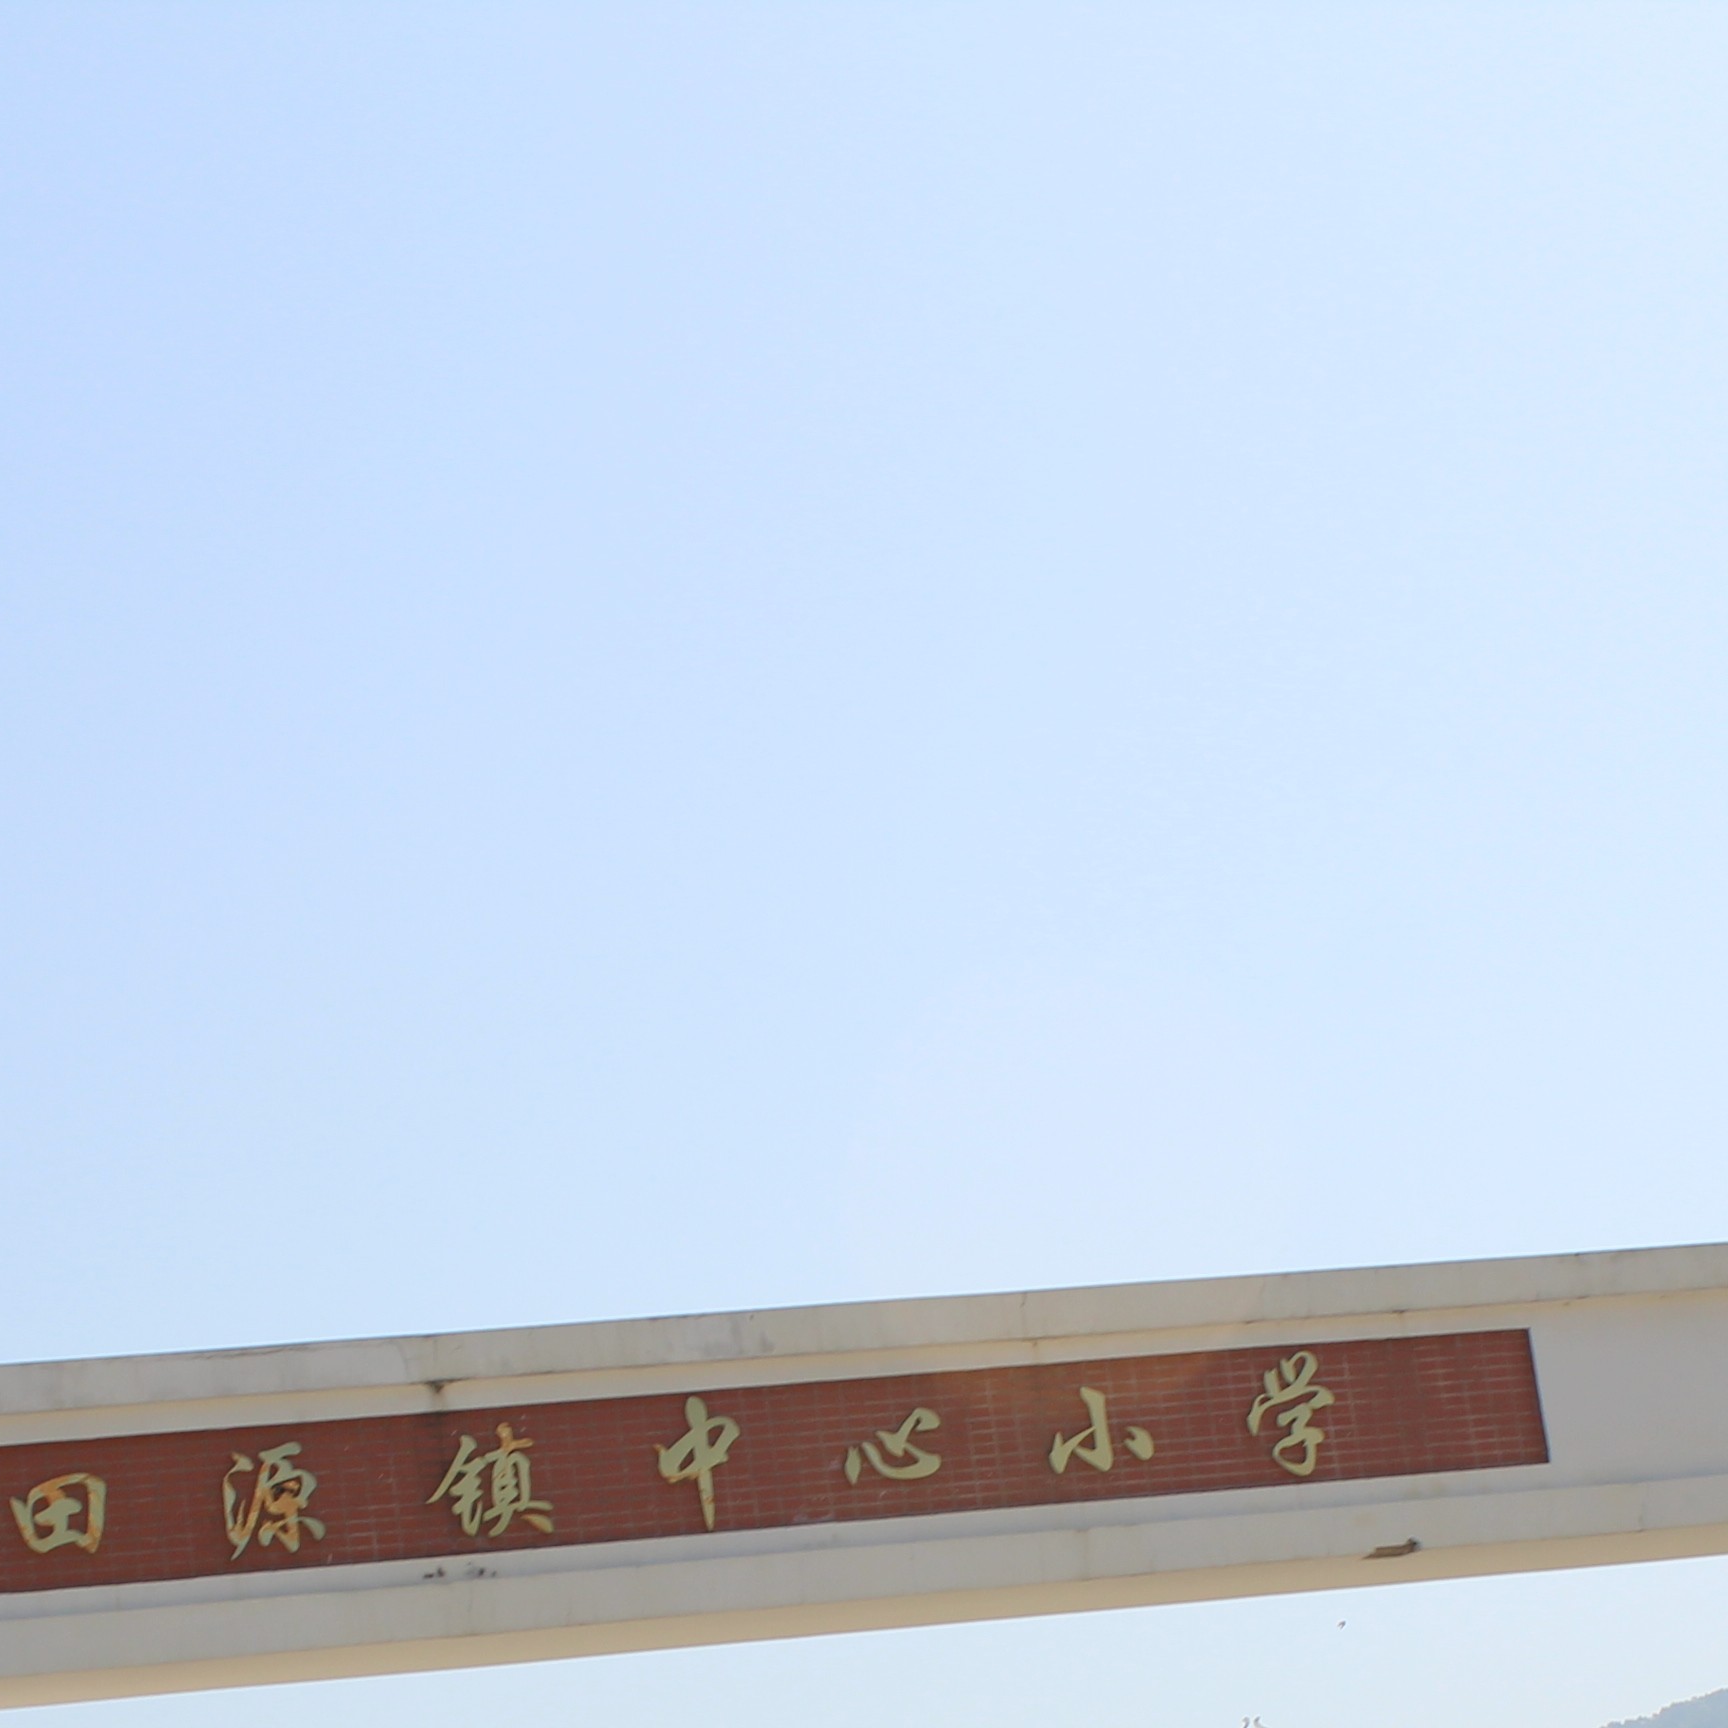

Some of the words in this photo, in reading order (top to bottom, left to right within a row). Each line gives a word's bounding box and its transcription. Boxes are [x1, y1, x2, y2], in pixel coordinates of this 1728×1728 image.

[9, 1350, 1335, 1560] 田源镇中心小学
